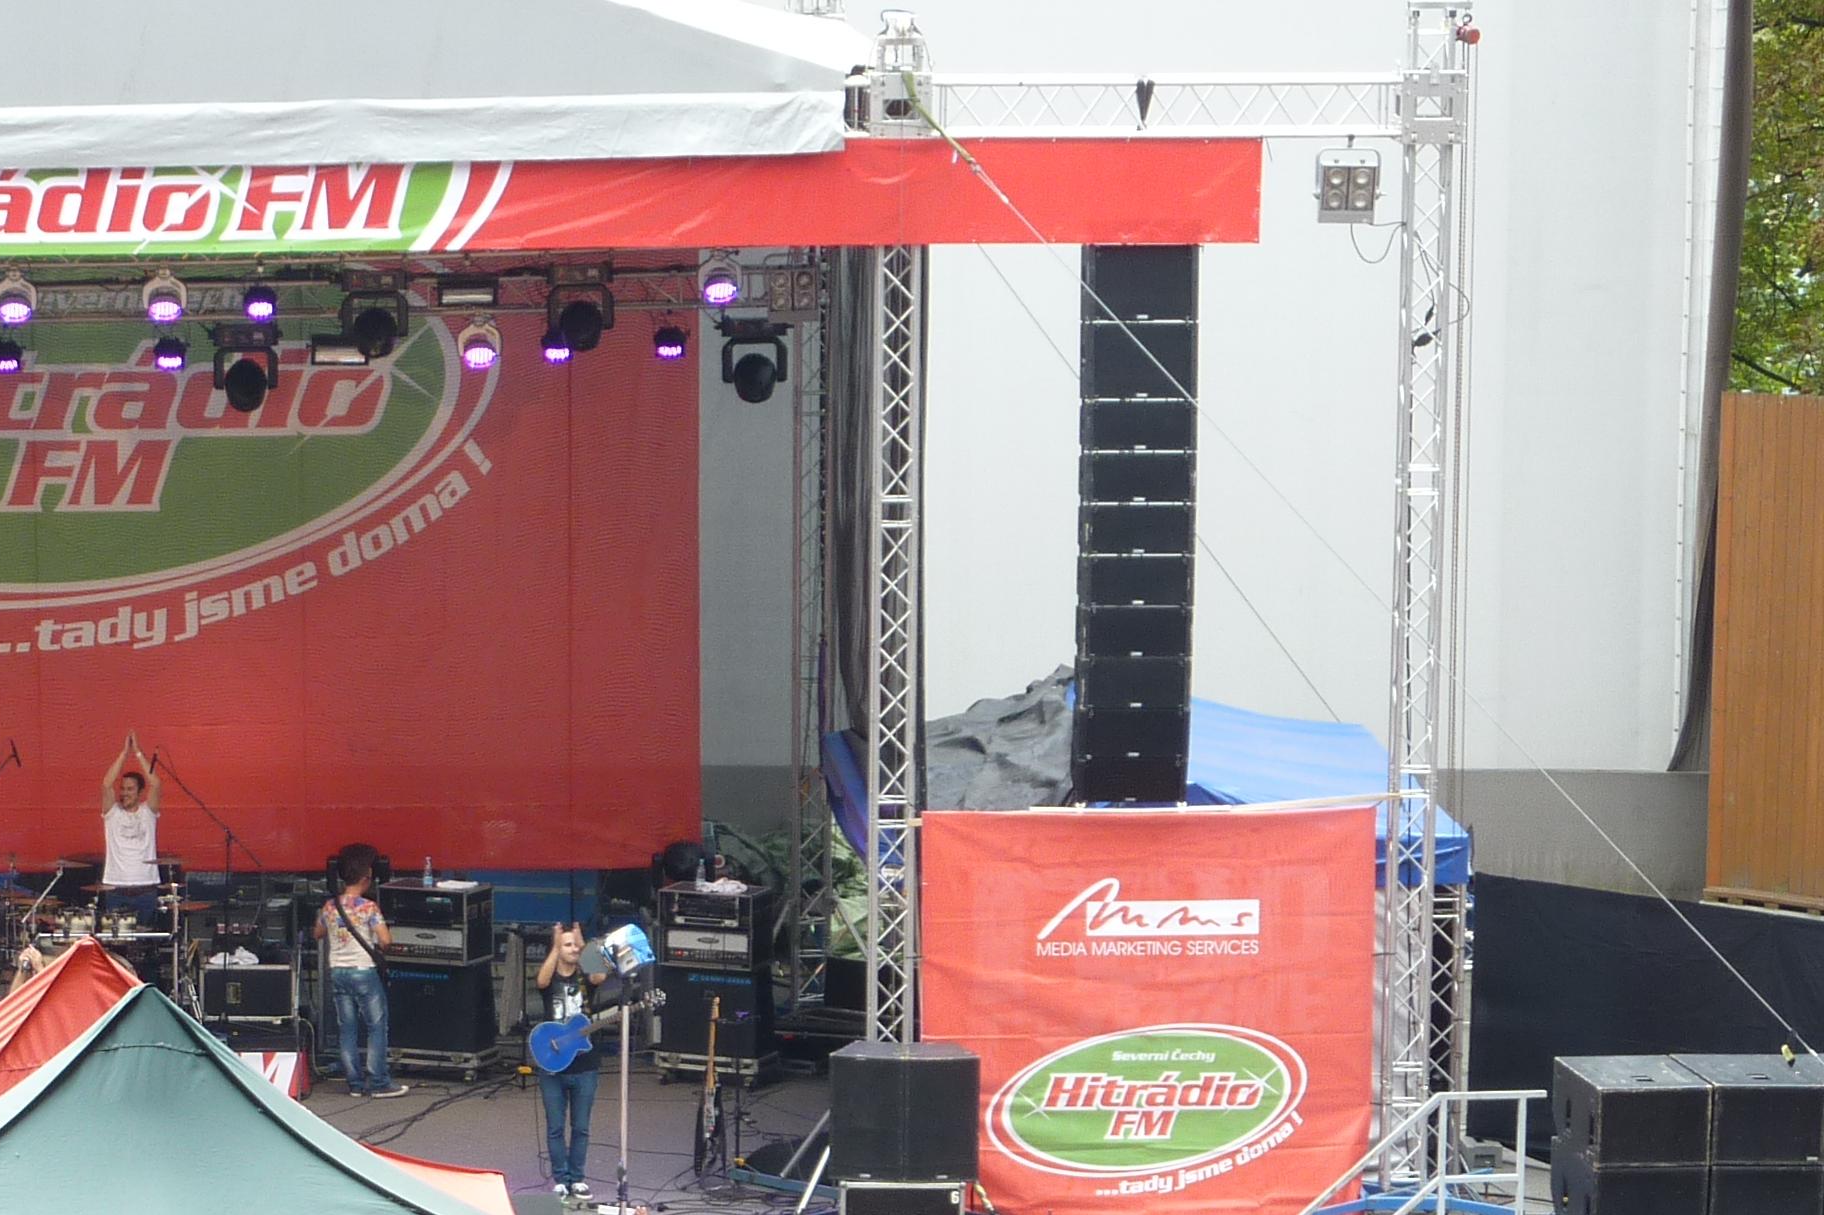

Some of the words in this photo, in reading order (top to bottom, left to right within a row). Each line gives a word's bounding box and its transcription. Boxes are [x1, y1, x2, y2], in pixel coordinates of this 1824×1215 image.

[232, 162, 409, 234] FM
[5, 438, 175, 507] FM
[173, 560, 320, 642] jsme
[326, 469, 472, 577] doma
[1036, 941, 1088, 957] MEDIA
[1091, 940, 1183, 956] MARKETING
[1186, 939, 1260, 955] SERVICES
[1170, 1048, 1217, 1063] Čechy
[1042, 1072, 1264, 1109] Hitrádio
[1107, 1110, 1175, 1137] FM
[1095, 1174, 1174, 1195] ...tady
[1173, 1158, 1233, 1190] jsme
[1235, 1121, 1295, 1166] doma
[950, 1190, 960, 1205] 6
